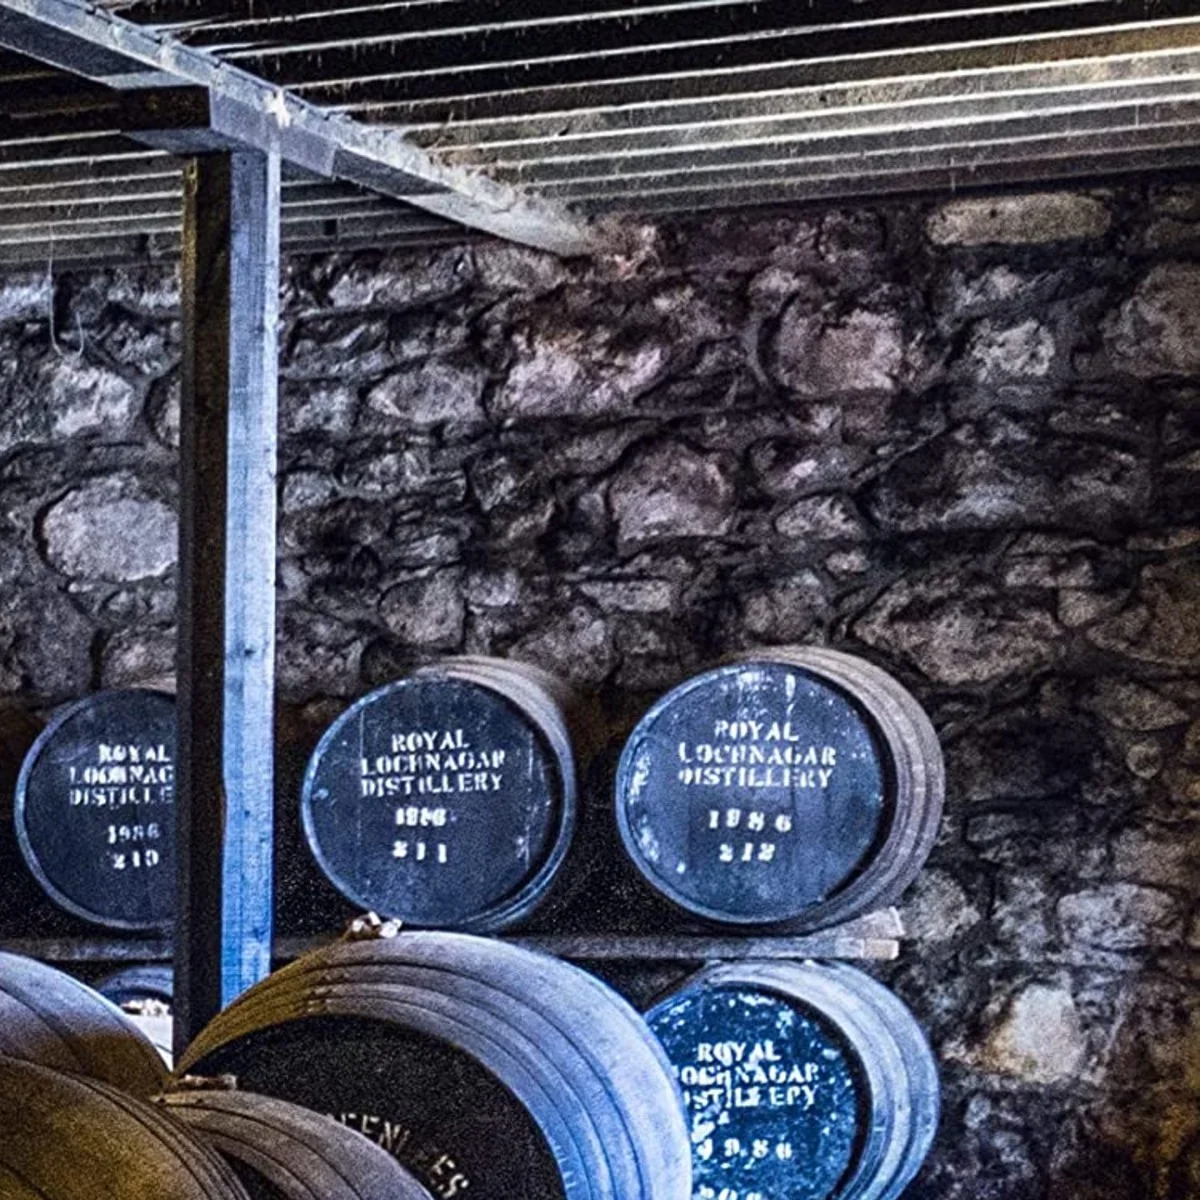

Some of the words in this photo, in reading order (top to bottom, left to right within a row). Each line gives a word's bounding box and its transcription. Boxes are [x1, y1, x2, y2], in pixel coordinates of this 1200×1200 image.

[392, 729, 471, 752] ROYAL
[714, 720, 799, 742] ROYAL
[99, 743, 172, 763] ROYAL
[361, 750, 506, 776] LOCHNAGAR
[678, 742, 836, 766] LOCHNAGAR
[361, 772, 502, 797] DISTILLERY
[678, 767, 833, 788] DISTILLERY
[697, 1039, 782, 1066] ROYAL
[680, 1061, 819, 1087] OCHNAGAR
[684, 1084, 819, 1112] ISTILLERY
